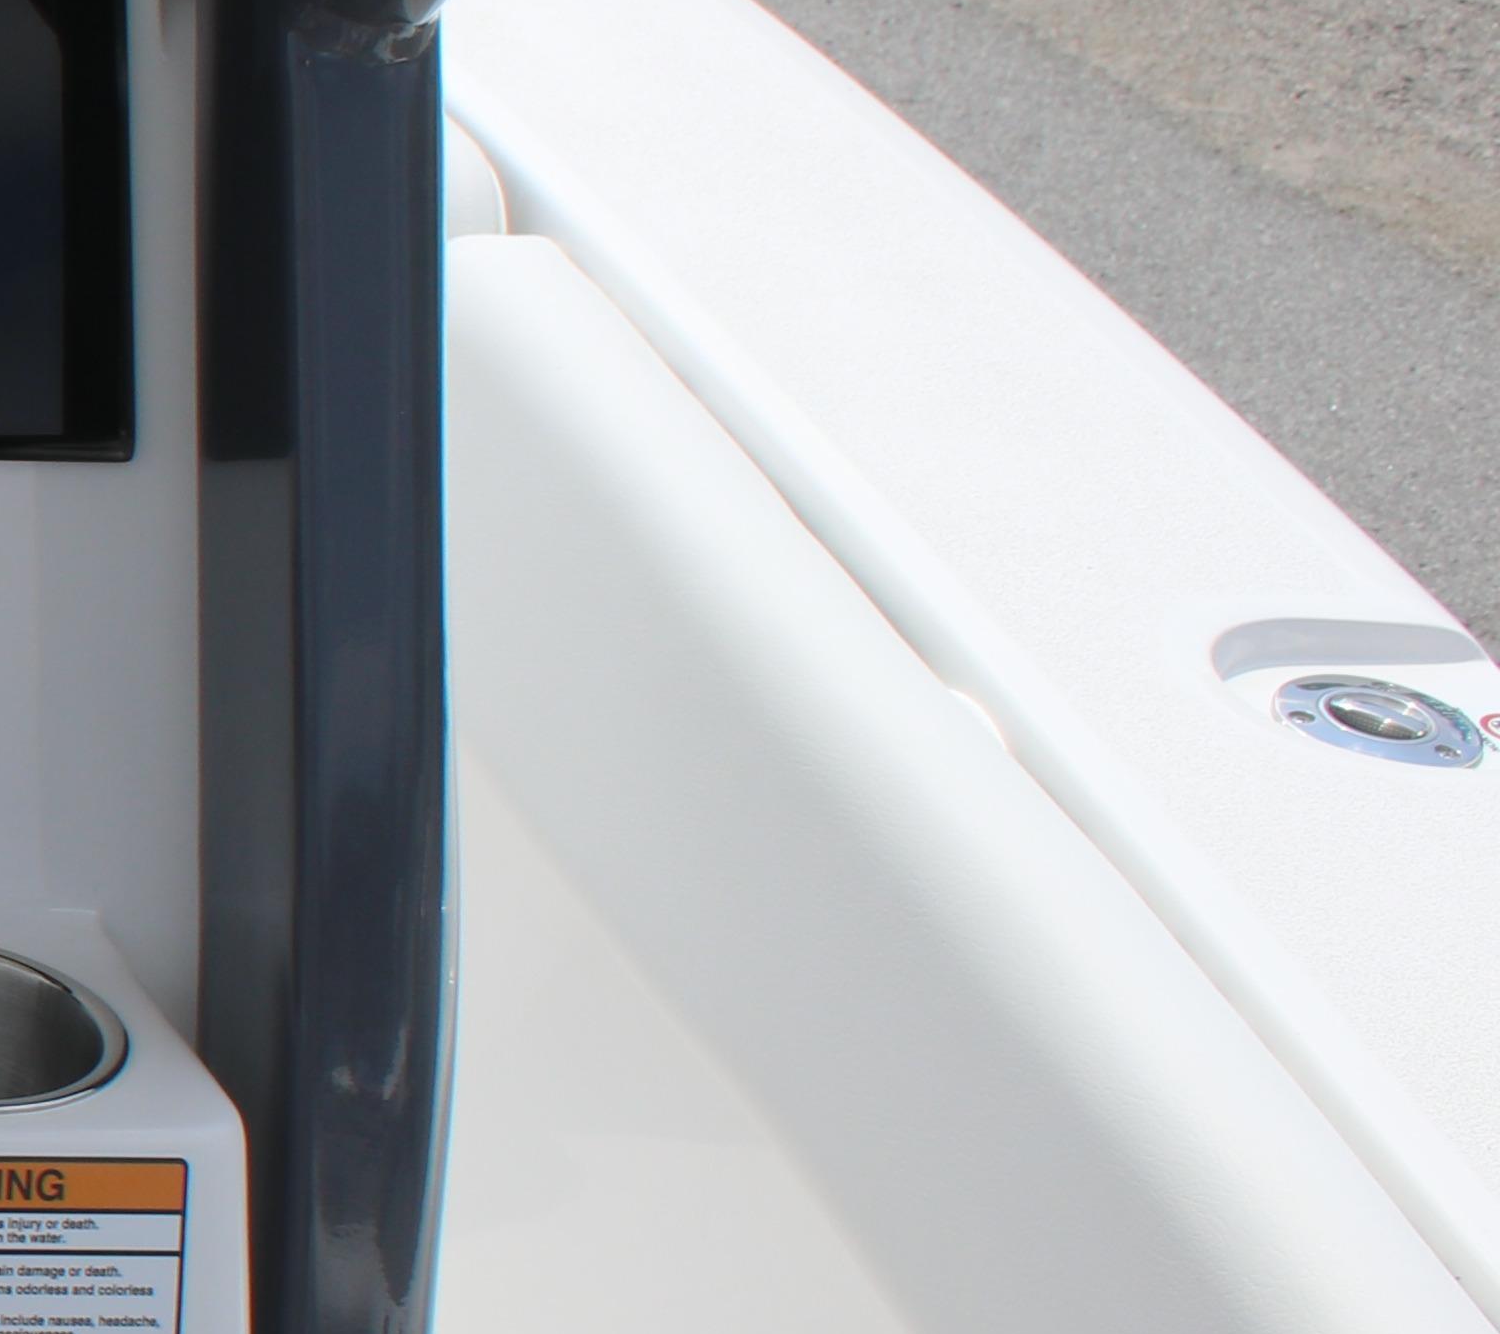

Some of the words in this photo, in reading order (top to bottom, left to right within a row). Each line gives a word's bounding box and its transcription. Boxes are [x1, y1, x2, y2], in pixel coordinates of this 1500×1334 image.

[7, 1217, 43, 1232] injury
[45, 1220, 60, 1230] or
[61, 1218, 99, 1230] death.
[16, 1265, 66, 1280] damage
[68, 1267, 83, 1278] or
[84, 1265, 122, 1278] death.
